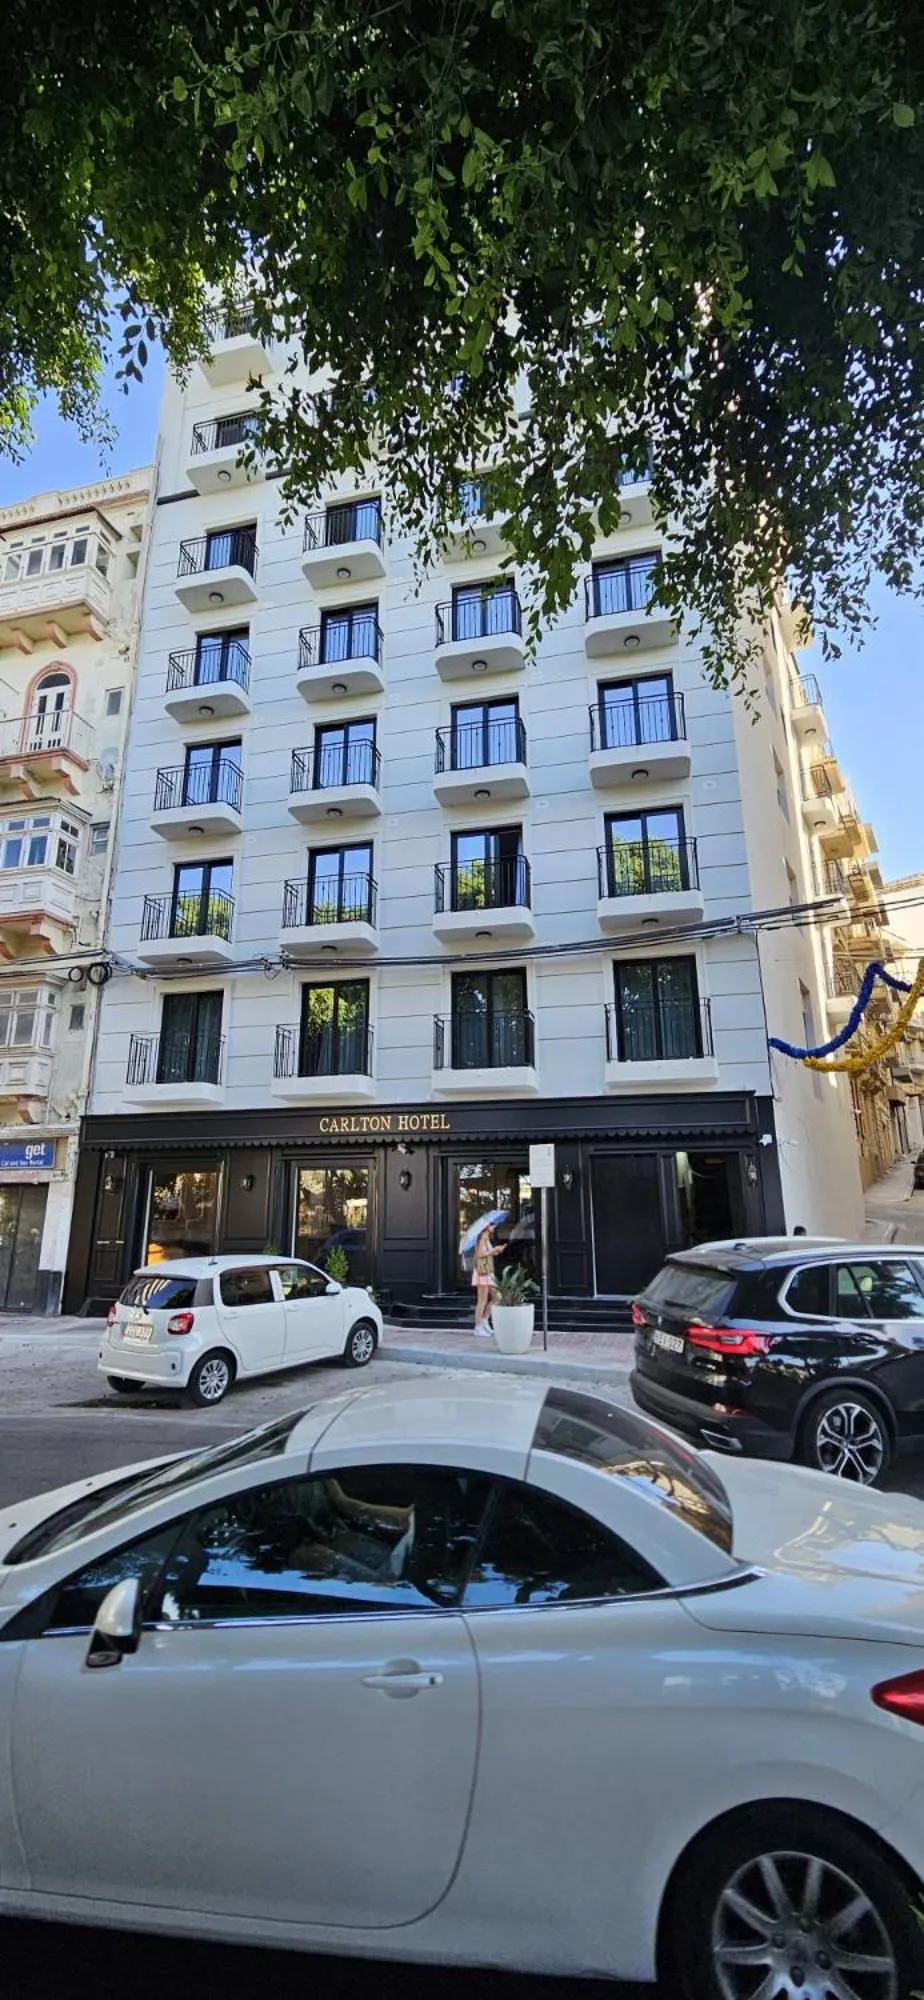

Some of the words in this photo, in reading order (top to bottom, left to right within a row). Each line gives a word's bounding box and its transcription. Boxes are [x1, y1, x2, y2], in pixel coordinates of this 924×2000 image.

[319, 1115, 391, 1132] CARLTON
[398, 1114, 450, 1130] HOTEL
[25, 1143, 45, 1160] get
